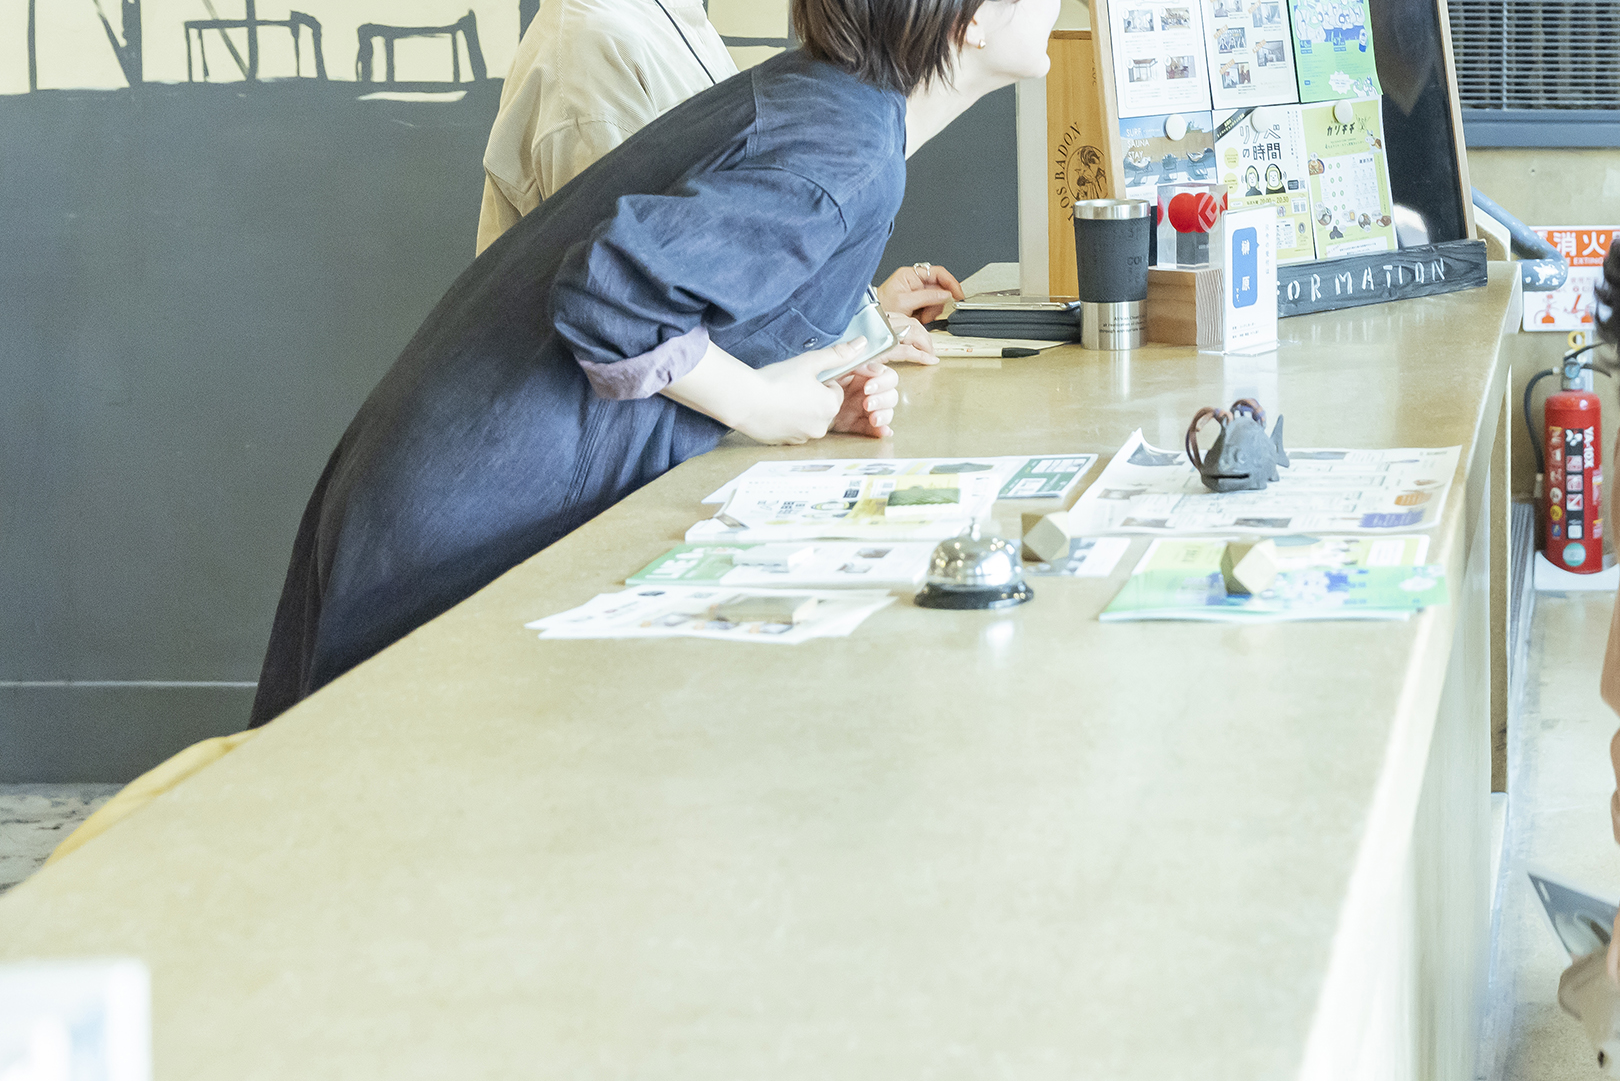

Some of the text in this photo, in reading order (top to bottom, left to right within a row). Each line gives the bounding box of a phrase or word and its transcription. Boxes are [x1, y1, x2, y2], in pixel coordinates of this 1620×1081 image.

[1126, 128, 1141, 137] SURF
[1127, 139, 1150, 148] SAUNA
[1055, 122, 1082, 180] BADON
[1128, 150, 1143, 159] STAY
[1243, 142, 1282, 161] の時間
